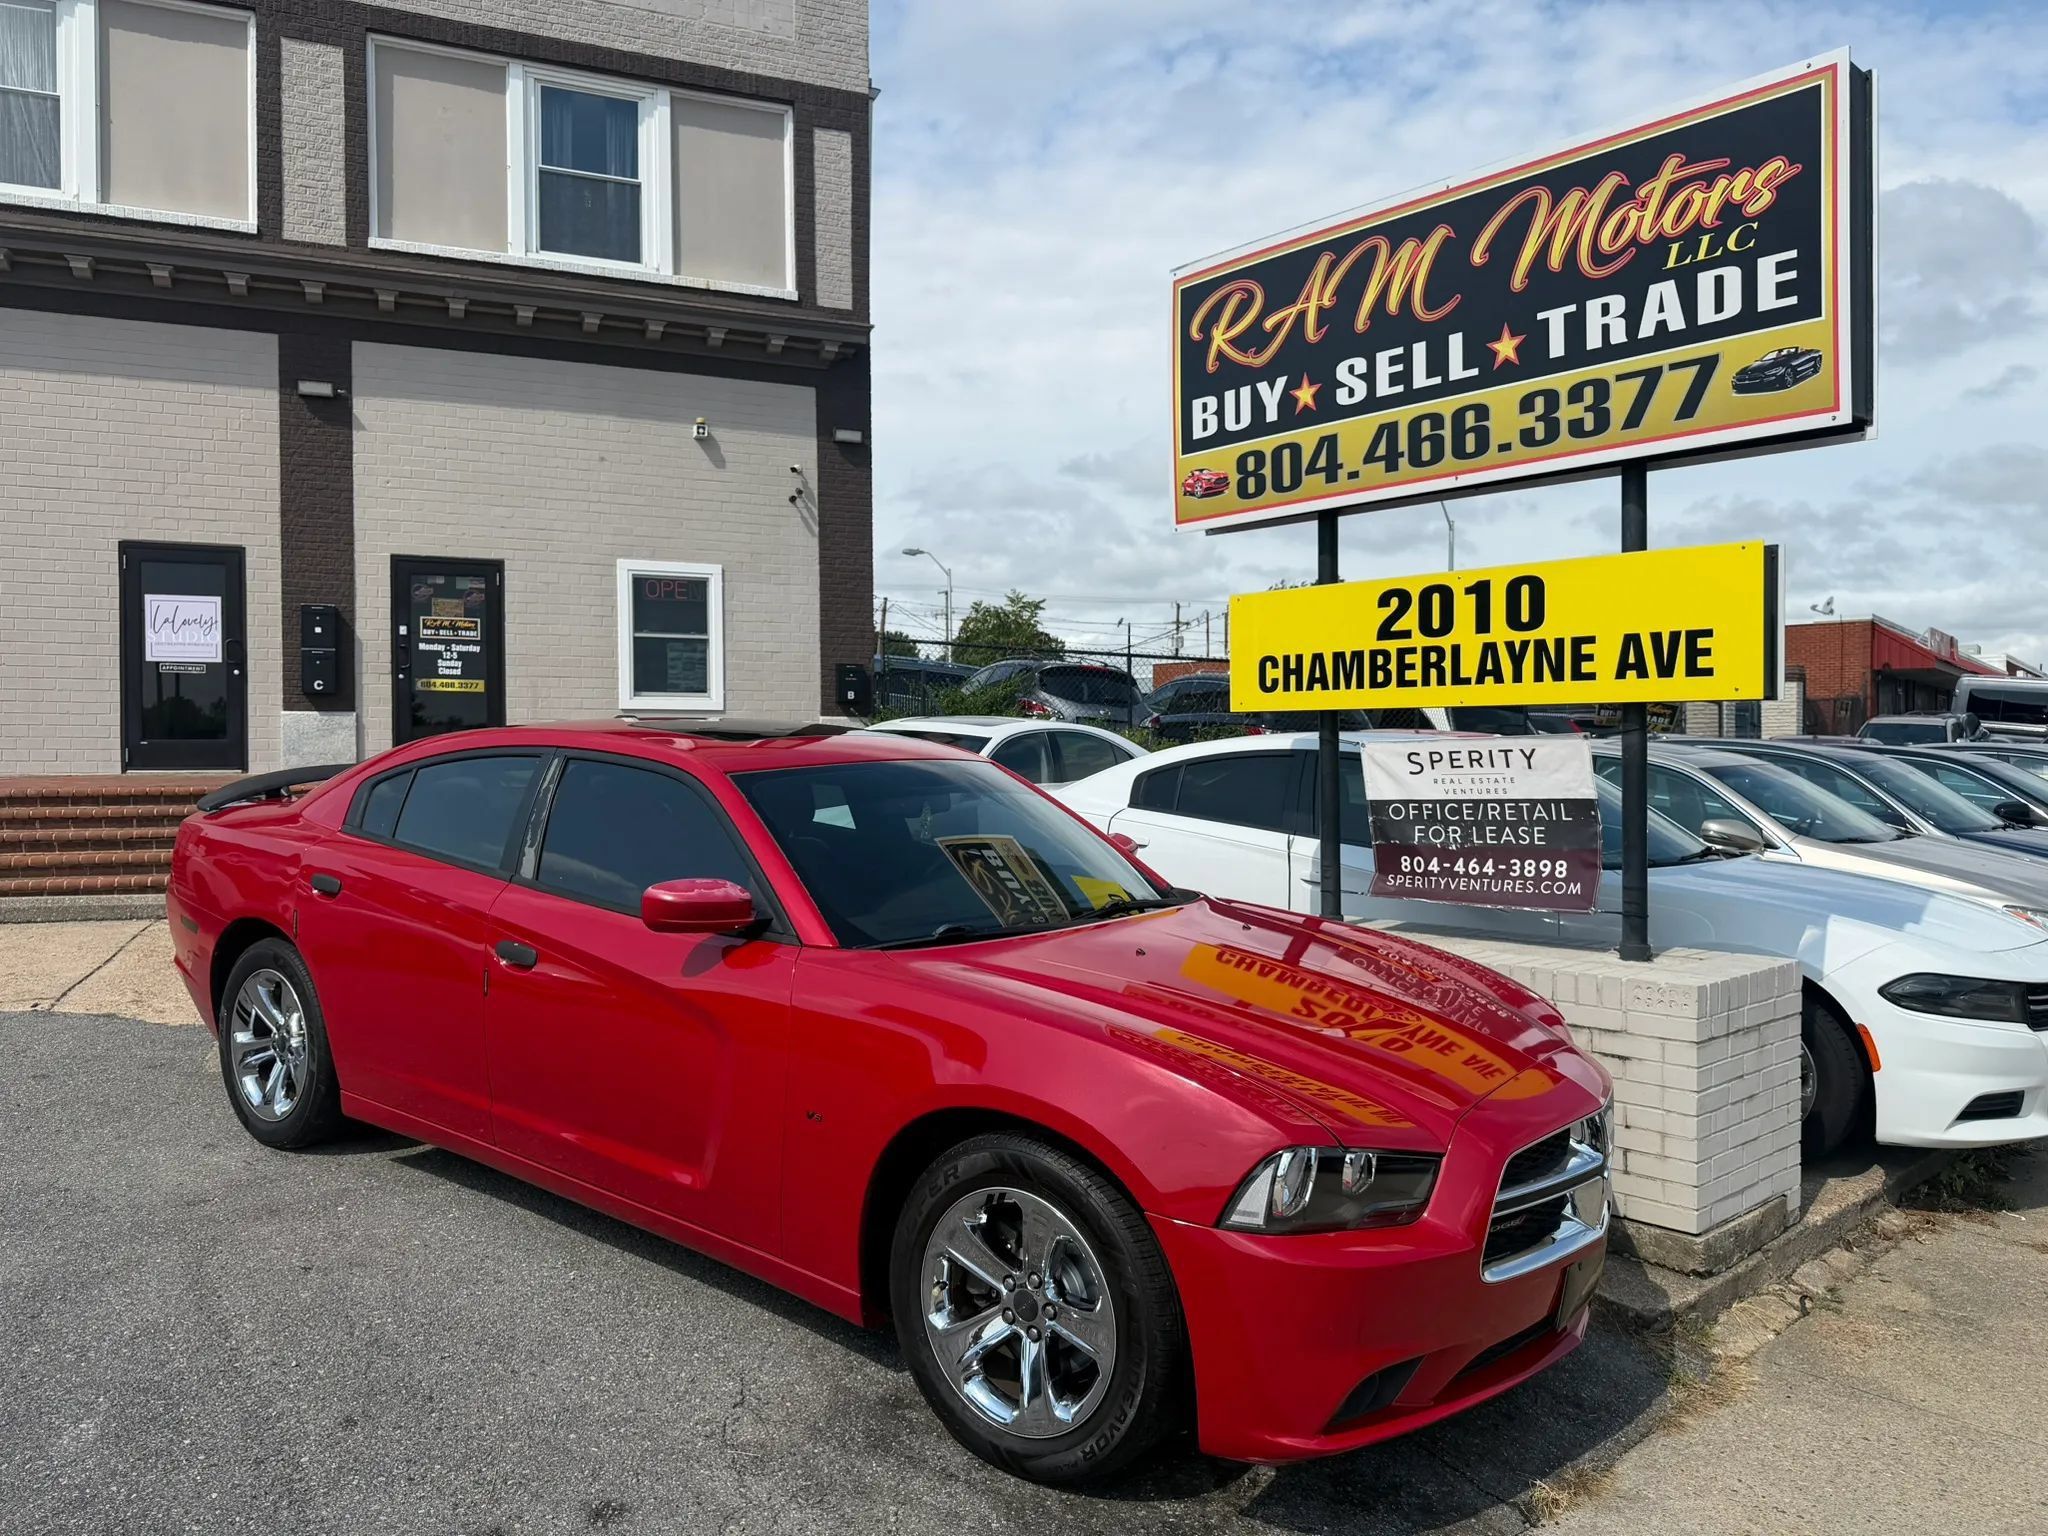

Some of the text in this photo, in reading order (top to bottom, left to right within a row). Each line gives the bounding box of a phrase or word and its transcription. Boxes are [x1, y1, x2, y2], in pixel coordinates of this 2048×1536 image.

[1662, 221, 1759, 271] LLC
[1190, 153, 1802, 374] RAM Motors
[1192, 249, 1799, 441] BUY SELL TRADE
[1235, 352, 1724, 501] 804.466.3377
[1375, 574, 1547, 642] 2010
[418, 642, 446, 652] Monday
[450, 643, 481, 653] Saturday
[442, 651, 458, 659] 12-5
[437, 659, 463, 667] Sunday
[438, 667, 462, 675] Closed
[1257, 628, 1715, 694] CHAMBERLAYNE AVE
[313, 680, 324, 690] C
[847, 690, 855, 700] B
[1407, 748, 1536, 775] SPERITY
[1433, 776, 1516, 785] REAL ESTATE
[1388, 802, 1573, 821] OFFICE/RETAIL
[1414, 825, 1547, 845] FOR LEASE
[1400, 855, 1568, 879] 804-464-3898
[1386, 874, 1581, 895] SPERITYVENTURES.COM
